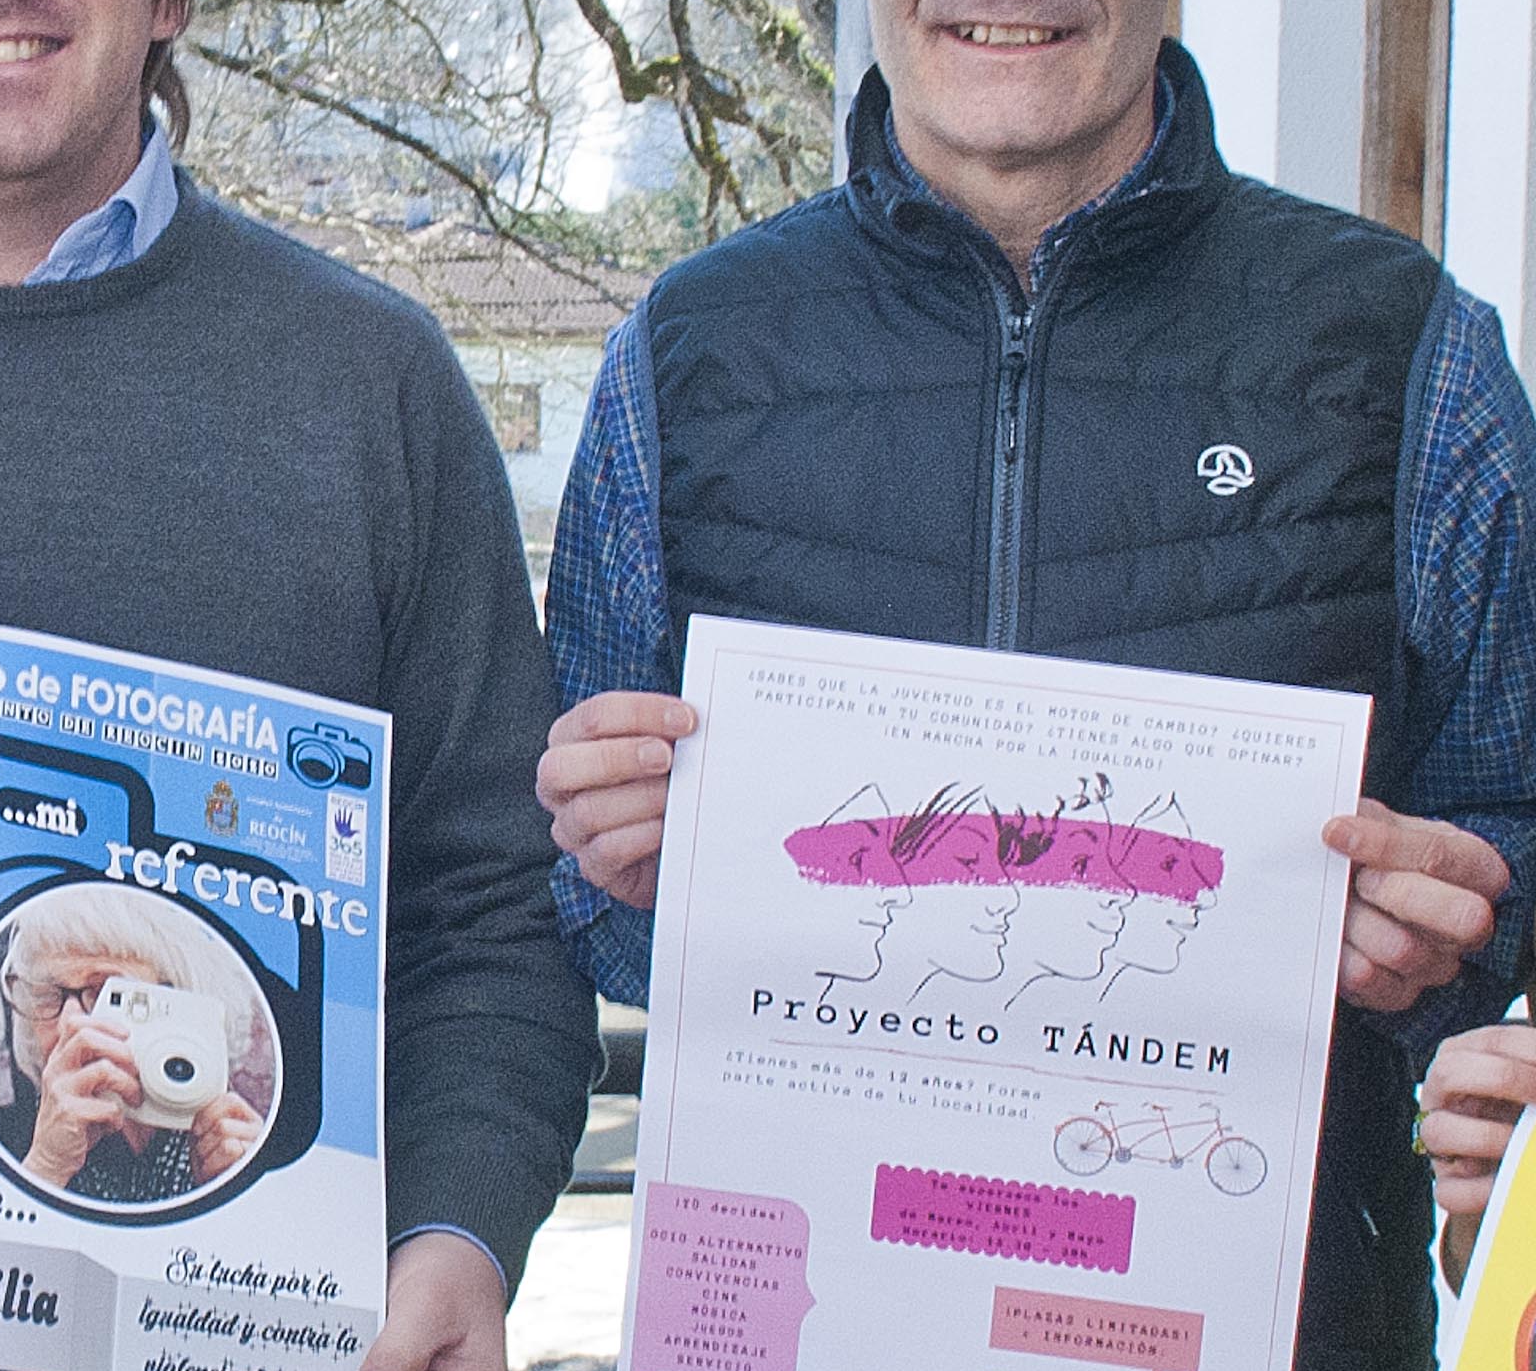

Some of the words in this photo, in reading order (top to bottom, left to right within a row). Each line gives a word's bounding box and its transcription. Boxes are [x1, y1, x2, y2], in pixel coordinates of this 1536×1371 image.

[15, 664, 60, 703] de
[71, 675, 277, 752] FOTOGRAFÍA
[103, 828, 368, 936] referente
[750, 988, 1001, 1046] Proyecto
[1043, 1023, 1228, 1073] TÁNDEM
[210, 1258, 268, 1289] lucha
[270, 1271, 311, 1299] por
[316, 1272, 339, 1300] la
[240, 1321, 255, 1346] y
[262, 1320, 330, 1349] contra
[336, 1326, 359, 1353] la
